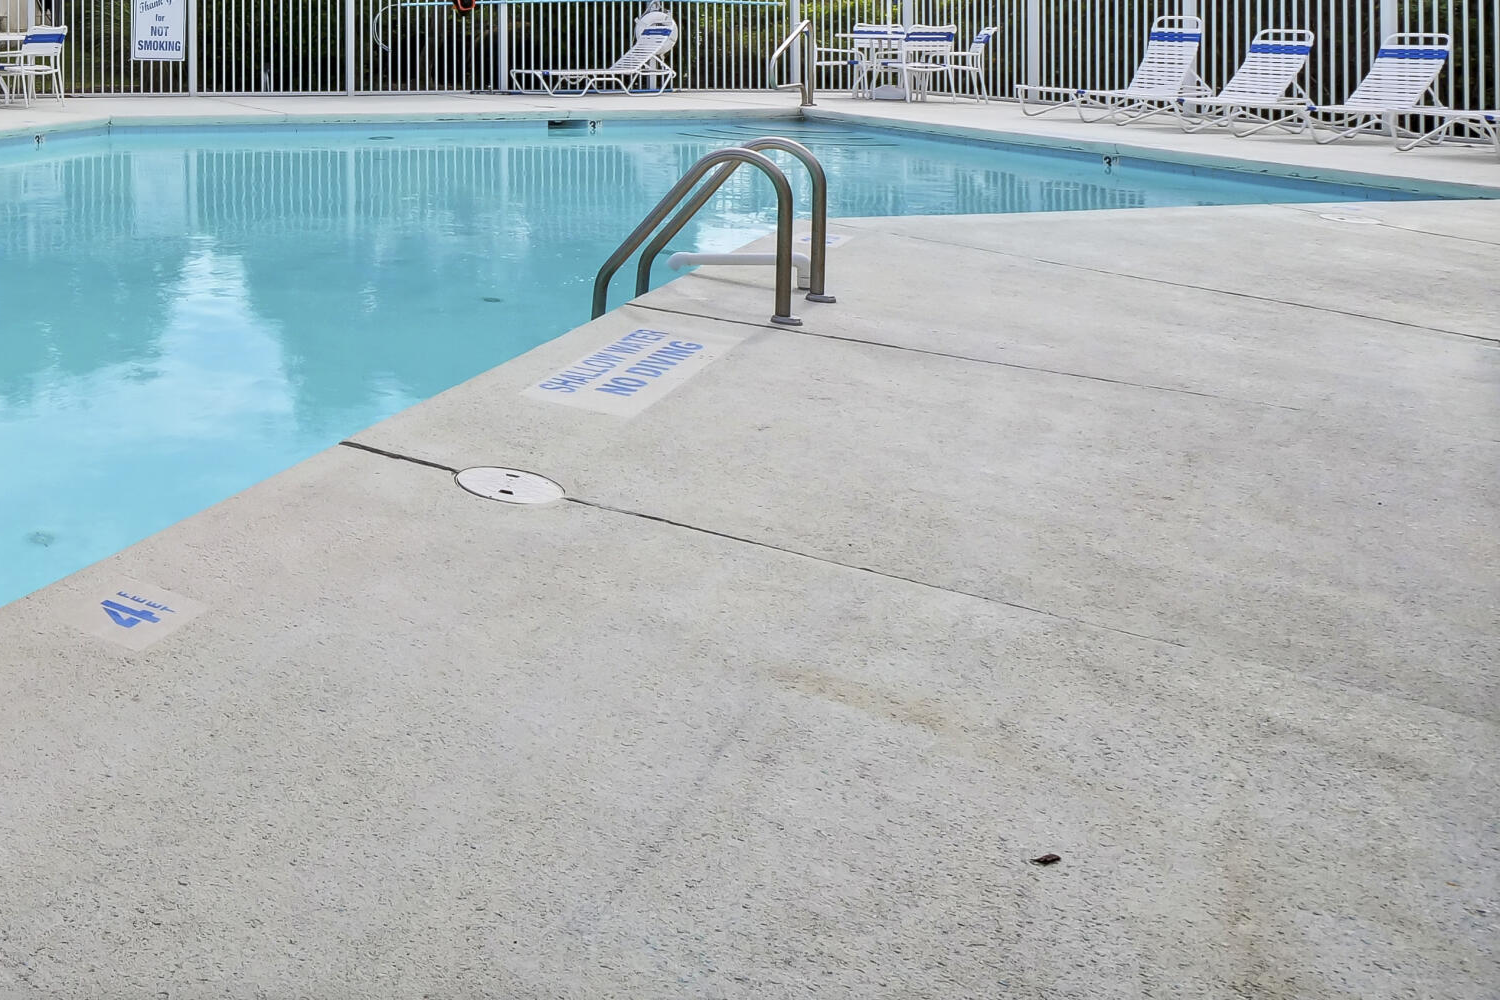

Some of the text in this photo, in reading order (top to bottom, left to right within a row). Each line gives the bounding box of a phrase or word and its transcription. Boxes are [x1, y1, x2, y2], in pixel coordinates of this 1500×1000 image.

[155, 14, 165, 22] for
[150, 26, 169, 36] NOT
[138, 40, 181, 51] SMOKING
[539, 329, 669, 393] SHALLOW WATER
[595, 340, 704, 396] NO DIVING
[116, 591, 176, 613] FEET
[100, 599, 161, 628] 4
